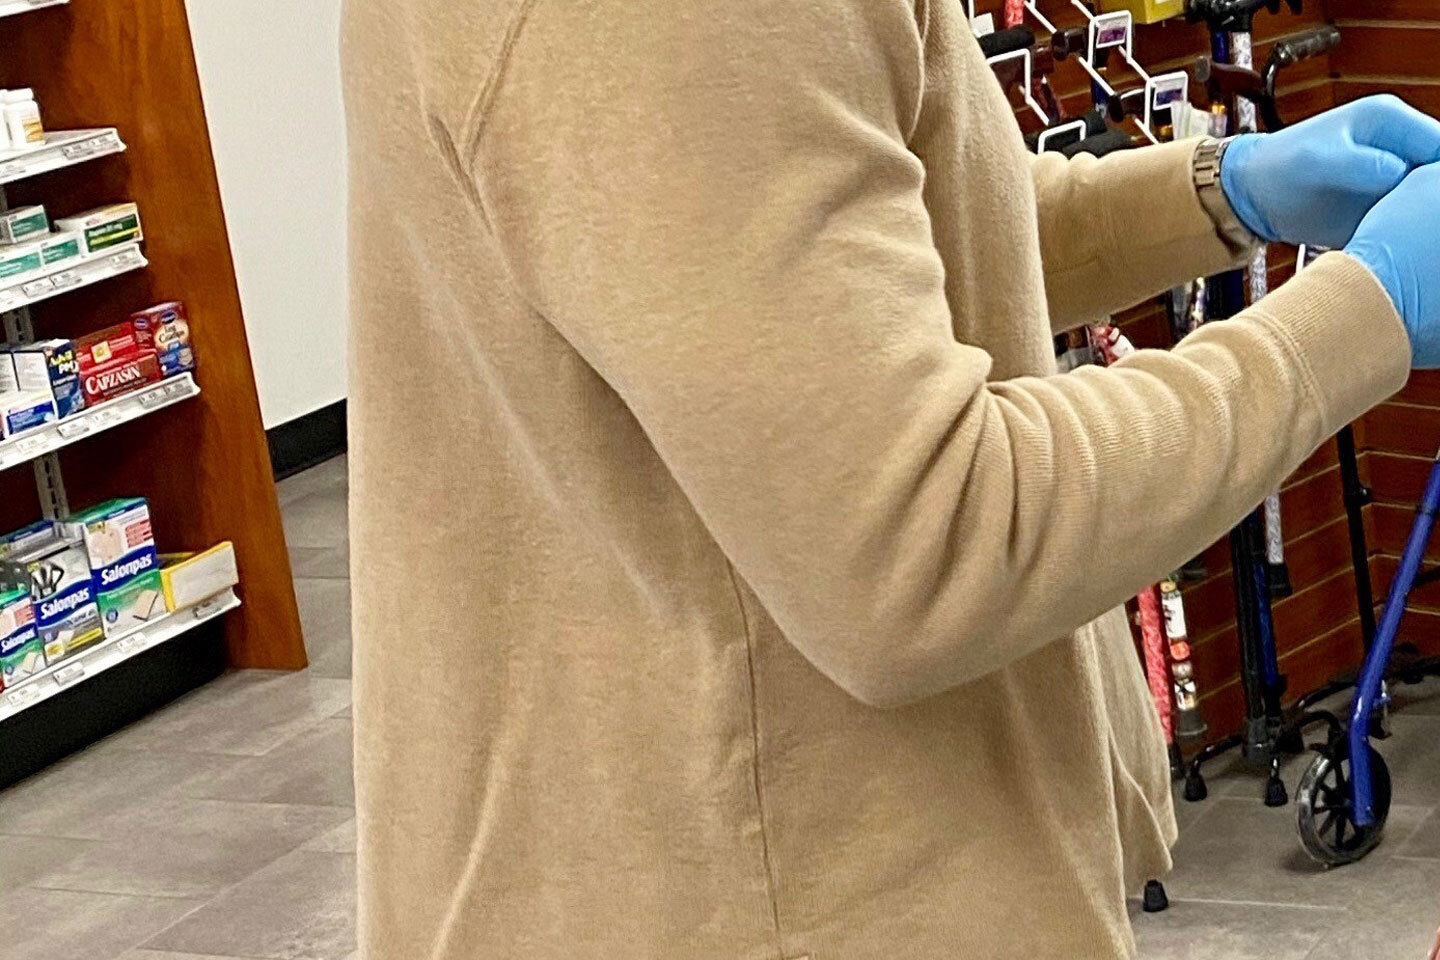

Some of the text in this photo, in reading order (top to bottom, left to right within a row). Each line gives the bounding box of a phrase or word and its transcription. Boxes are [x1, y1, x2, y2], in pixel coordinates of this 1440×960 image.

[100, 551, 153, 586] Salonpas
[40, 587, 90, 620] Salonpas
[0, 627, 36, 652] Salonpas
